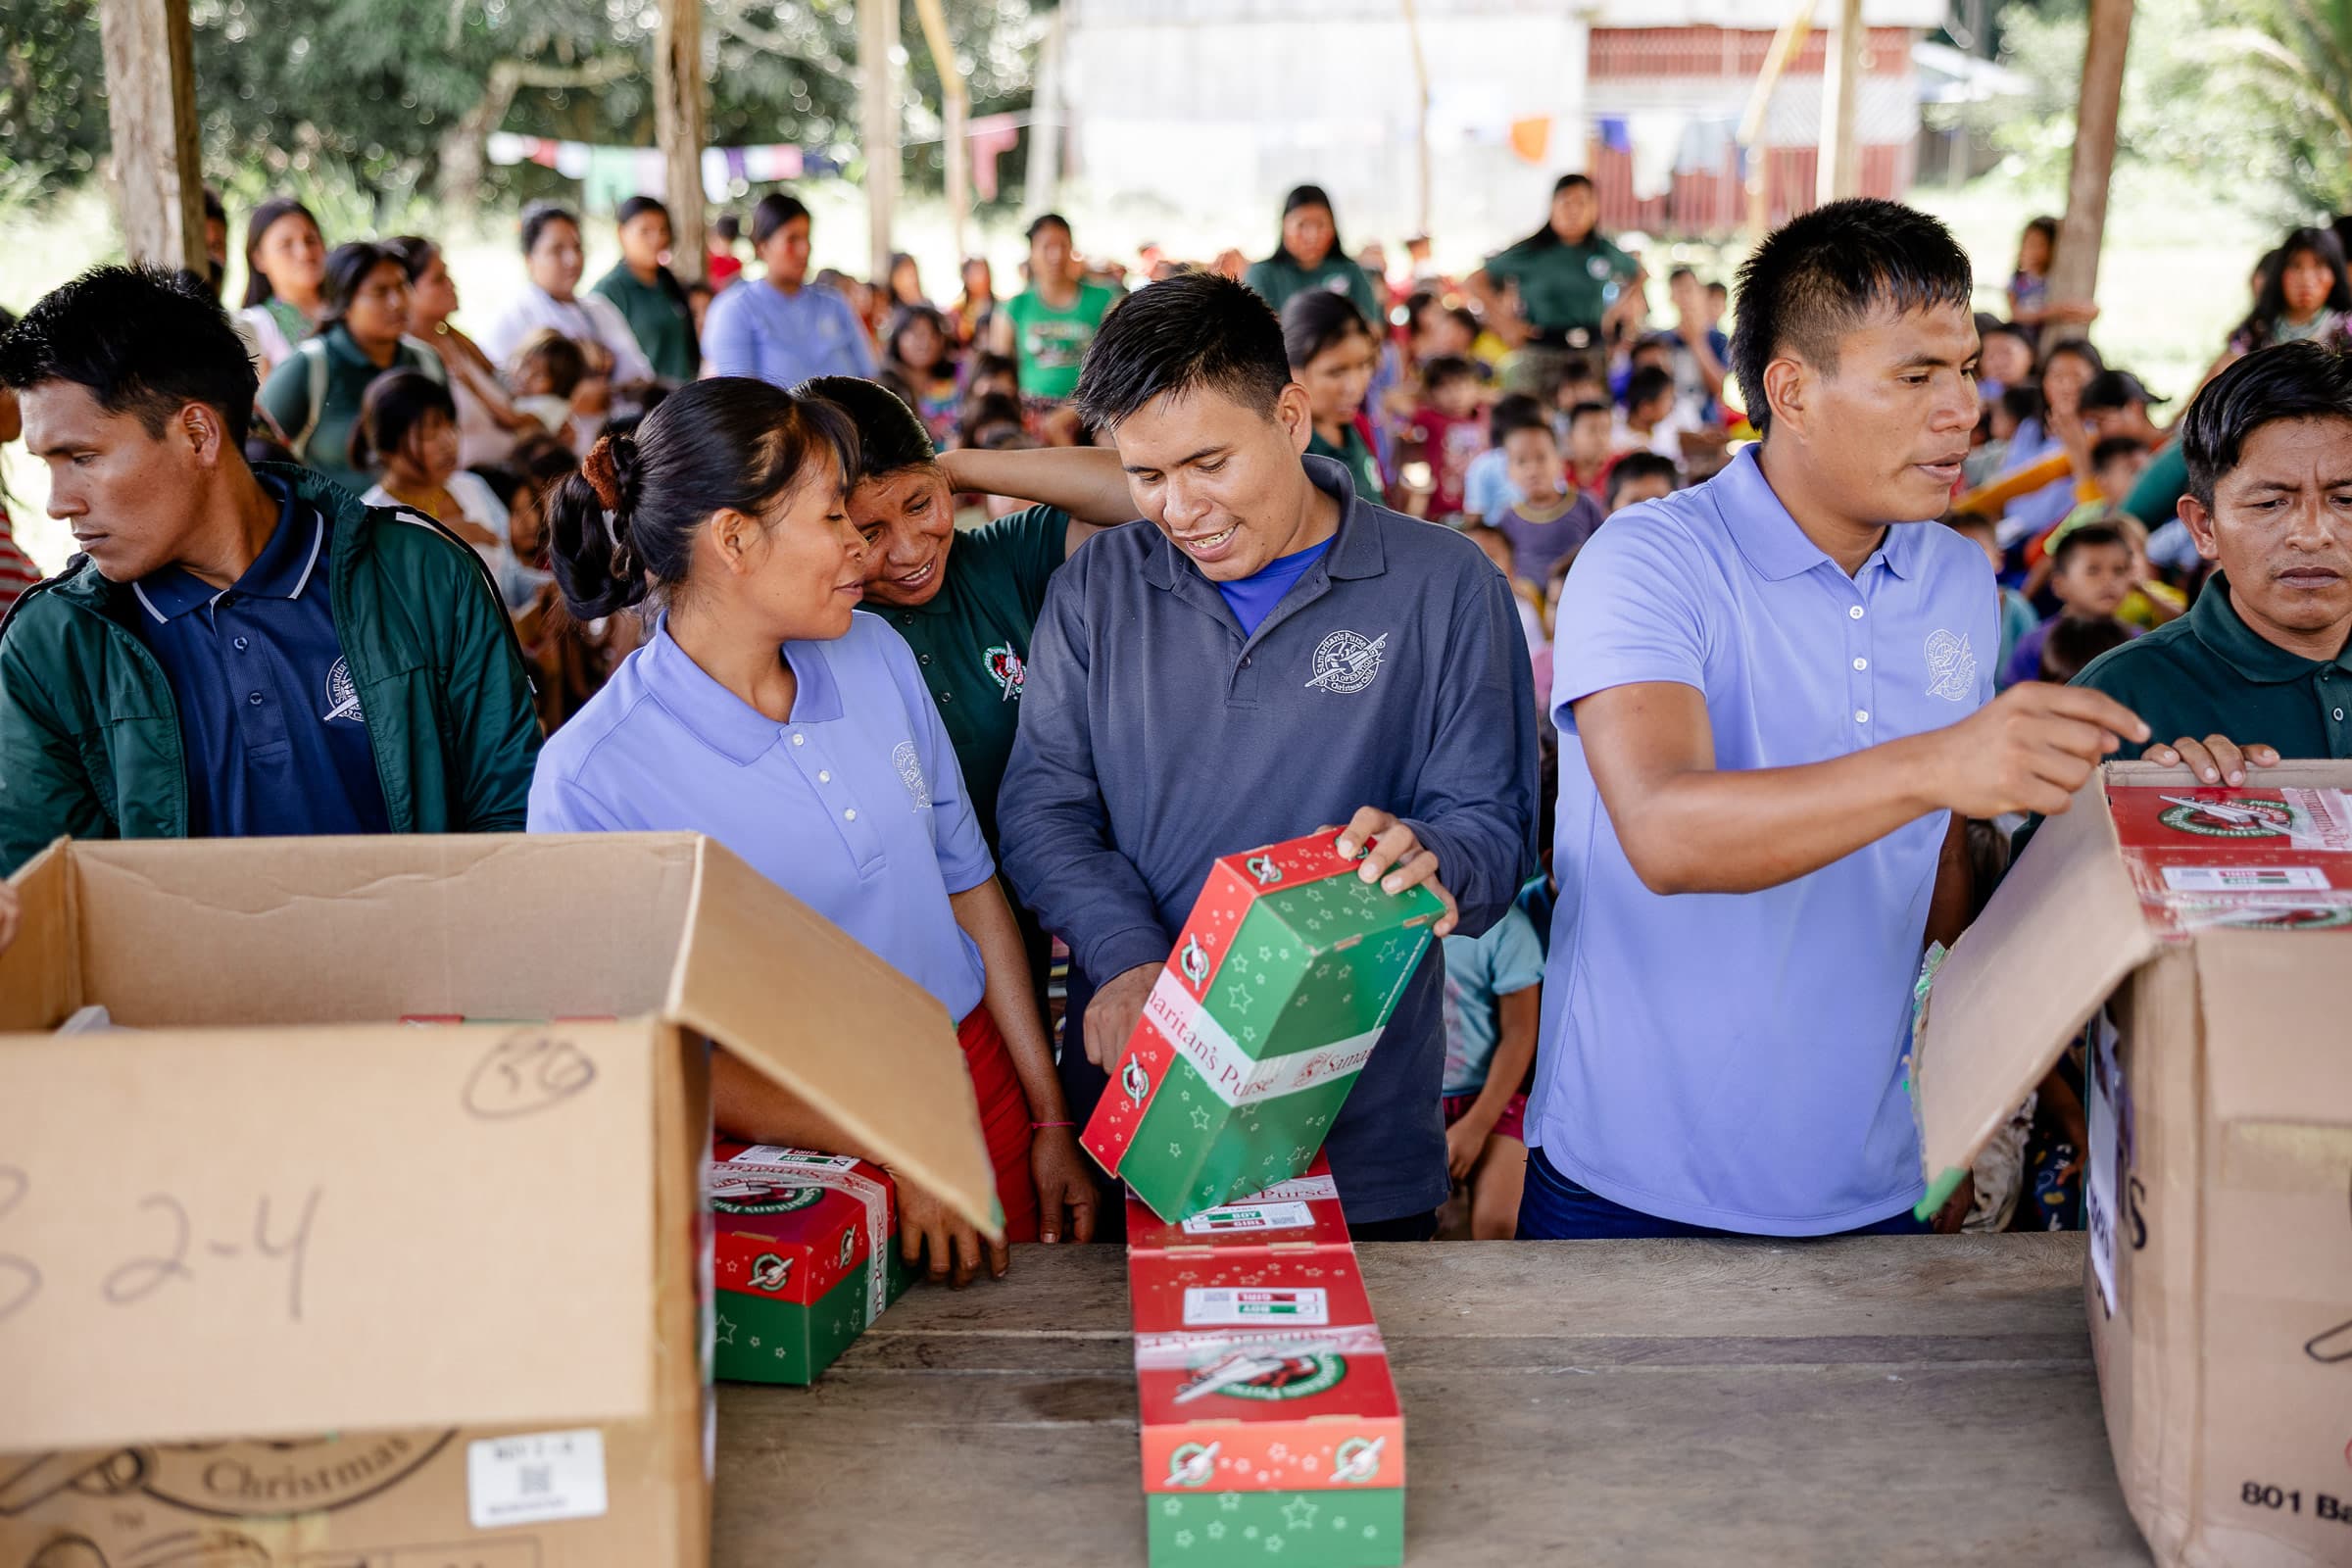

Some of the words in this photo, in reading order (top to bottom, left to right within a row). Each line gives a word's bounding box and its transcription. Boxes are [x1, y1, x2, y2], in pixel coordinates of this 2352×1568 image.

[1148, 989, 1218, 1071] aritan's
[101, 1182, 325, 1323] 2-4
[201, 1436, 413, 1500] Christmas
[2241, 1480, 2301, 1514] 801
